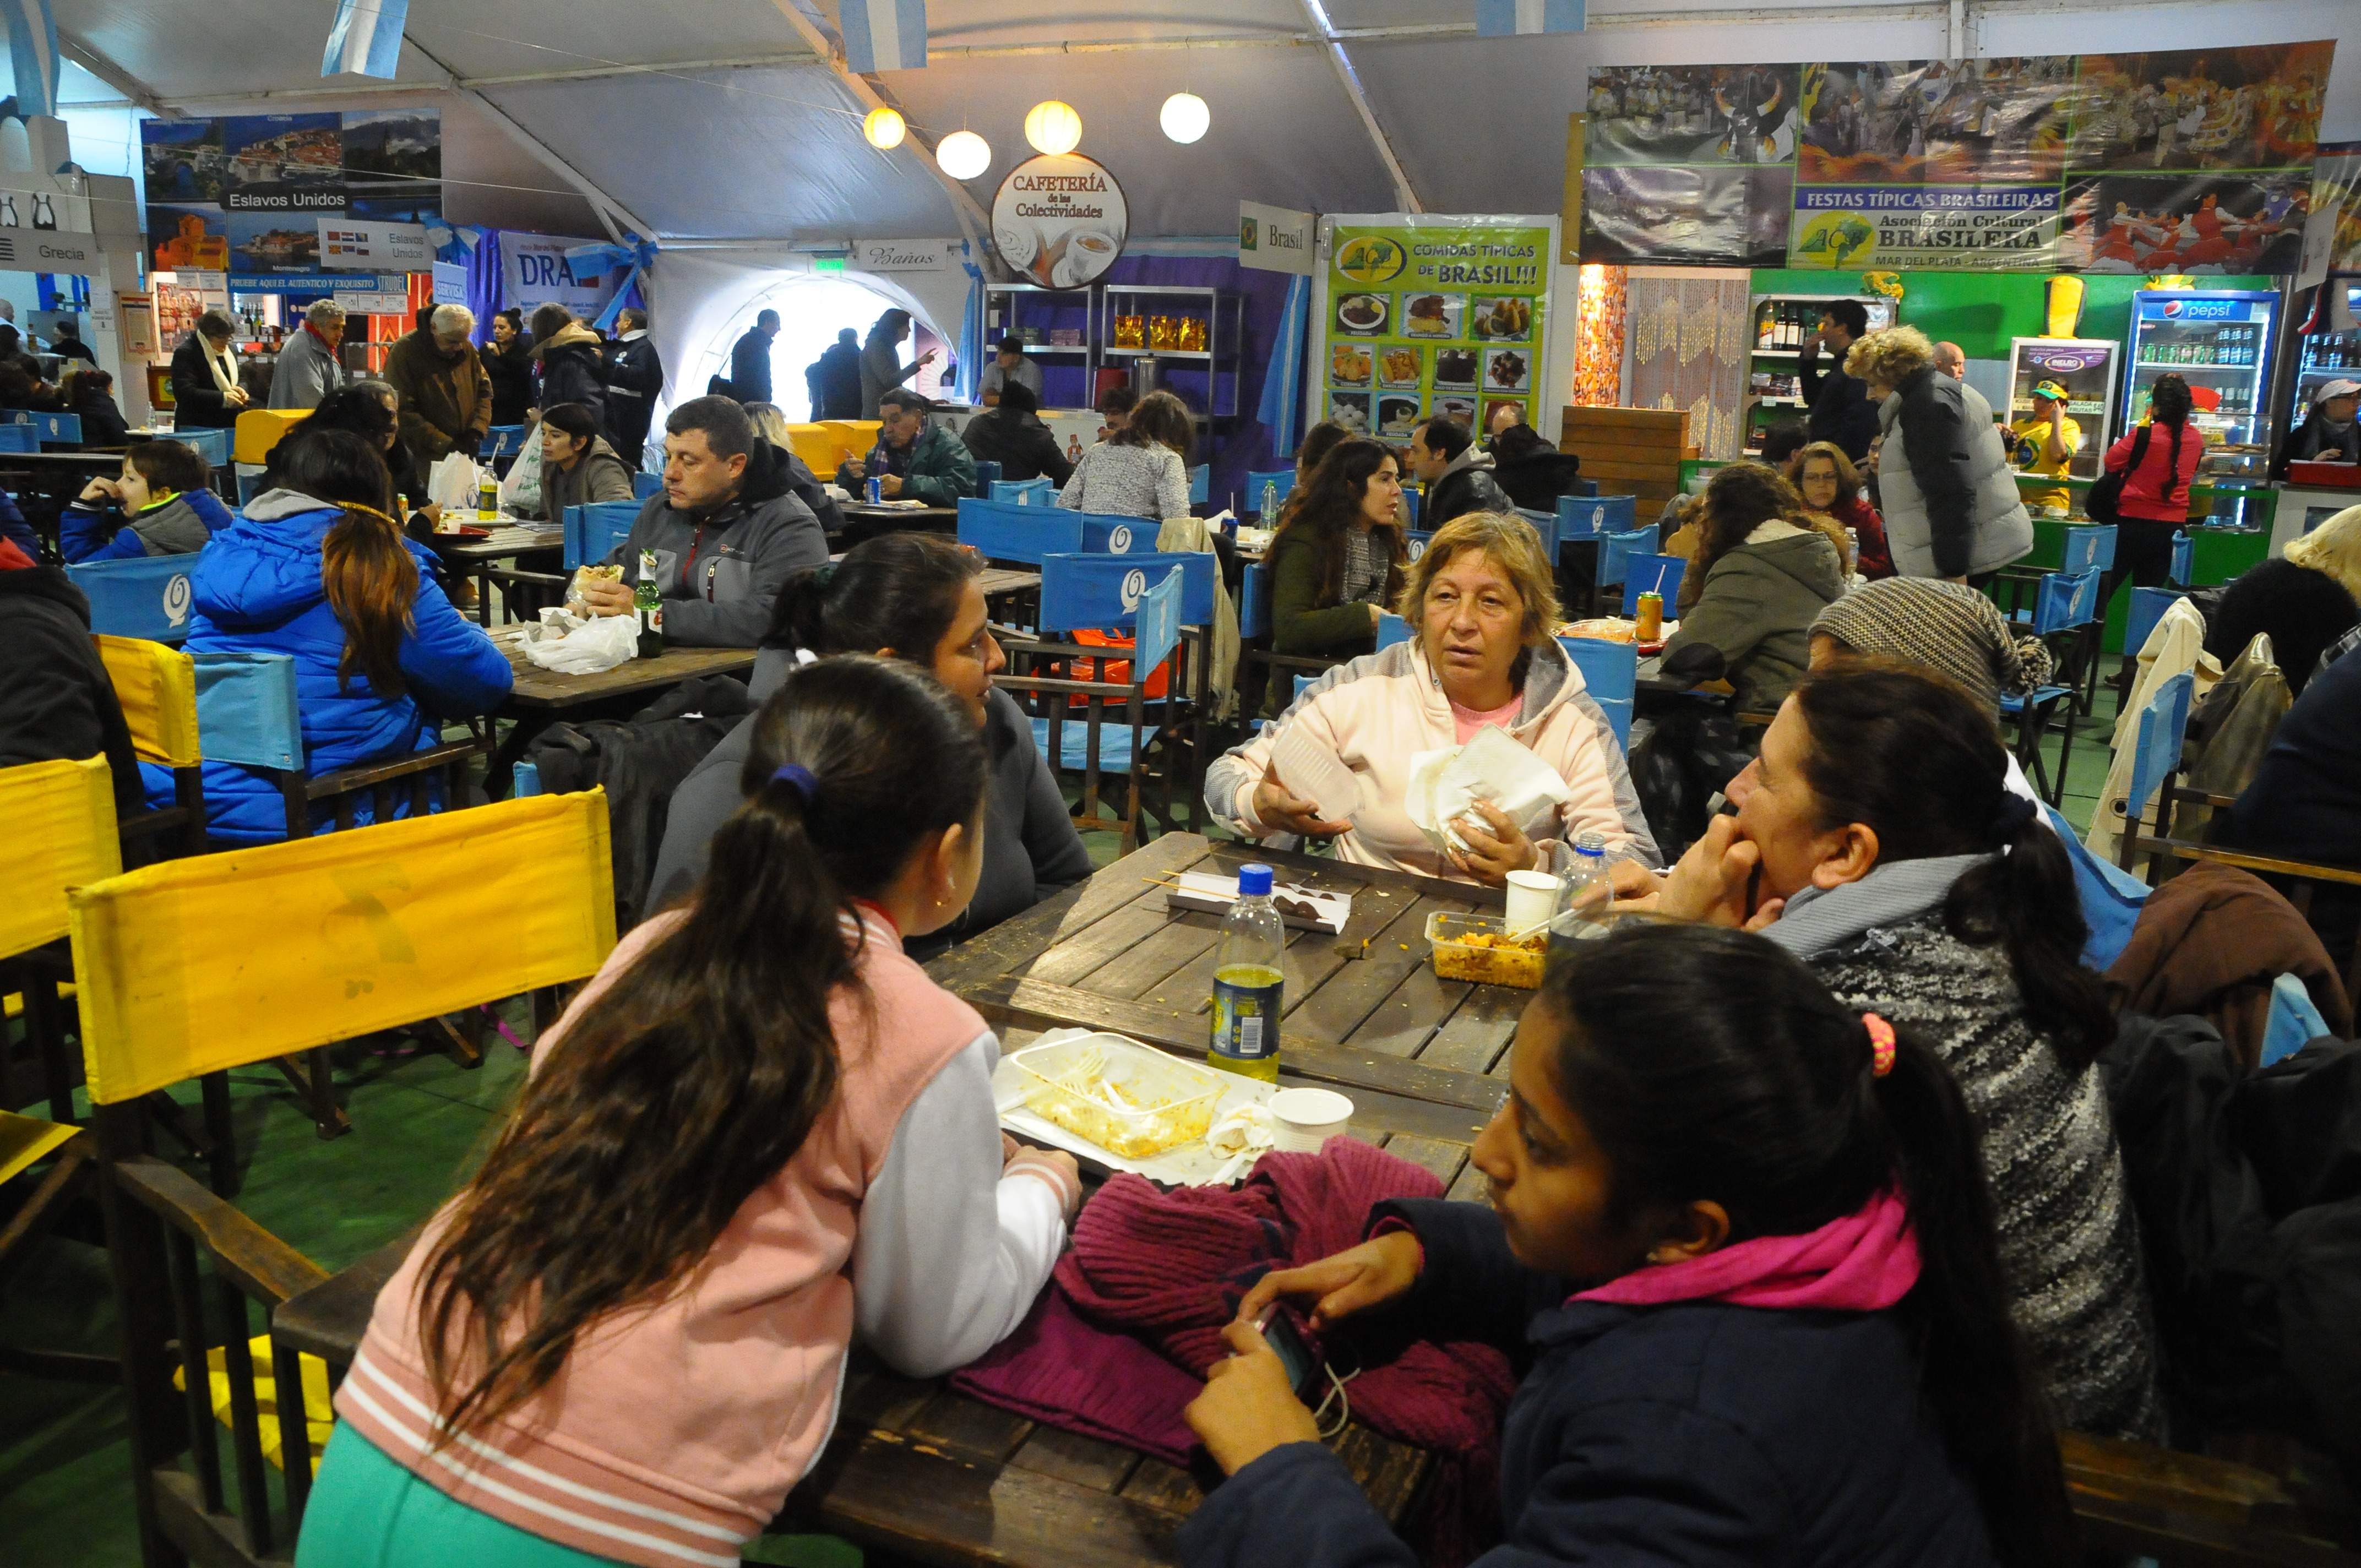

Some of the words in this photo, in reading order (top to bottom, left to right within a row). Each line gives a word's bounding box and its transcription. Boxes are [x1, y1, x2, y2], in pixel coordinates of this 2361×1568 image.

[1013, 172, 1108, 192] CAFETERÍA
[230, 193, 289, 207] Eslavos
[293, 193, 346, 206] Unidos
[1048, 193, 1058, 203] de
[1059, 194, 1071, 203] las
[1807, 193, 1864, 206] FESTAS
[1869, 190, 1935, 207] TÍPICAS
[1940, 193, 2054, 207] BRASILEIRAS
[1016, 203, 1103, 218] Colectividades
[1973, 215, 2044, 228] Cultural
[389, 233, 423, 245] Eslavos
[1269, 225, 1303, 250] Brasil
[1878, 230, 2041, 248] BRASILERA
[39, 245, 85, 260] Grecia
[393, 247, 423, 259] Unidos
[869, 247, 935, 265] Baños
[1413, 244, 1477, 257] COMIDAS
[1481, 242, 1535, 257] TÍPICAS
[1875, 256, 1902, 265] MAR
[1905, 257, 1924, 266] DEL
[1928, 257, 1962, 266] PLATA
[516, 254, 582, 287] DRA
[1418, 265, 1434, 275] DE
[1438, 264, 1537, 285] BRASIL!!!
[259, 279, 276, 287] AQUI
[288, 279, 327, 287] AUTENTICO
[335, 279, 374, 288] EXQUISITO
[377, 275, 405, 291] STRUDEL
[2188, 304, 2231, 318] pepsi
